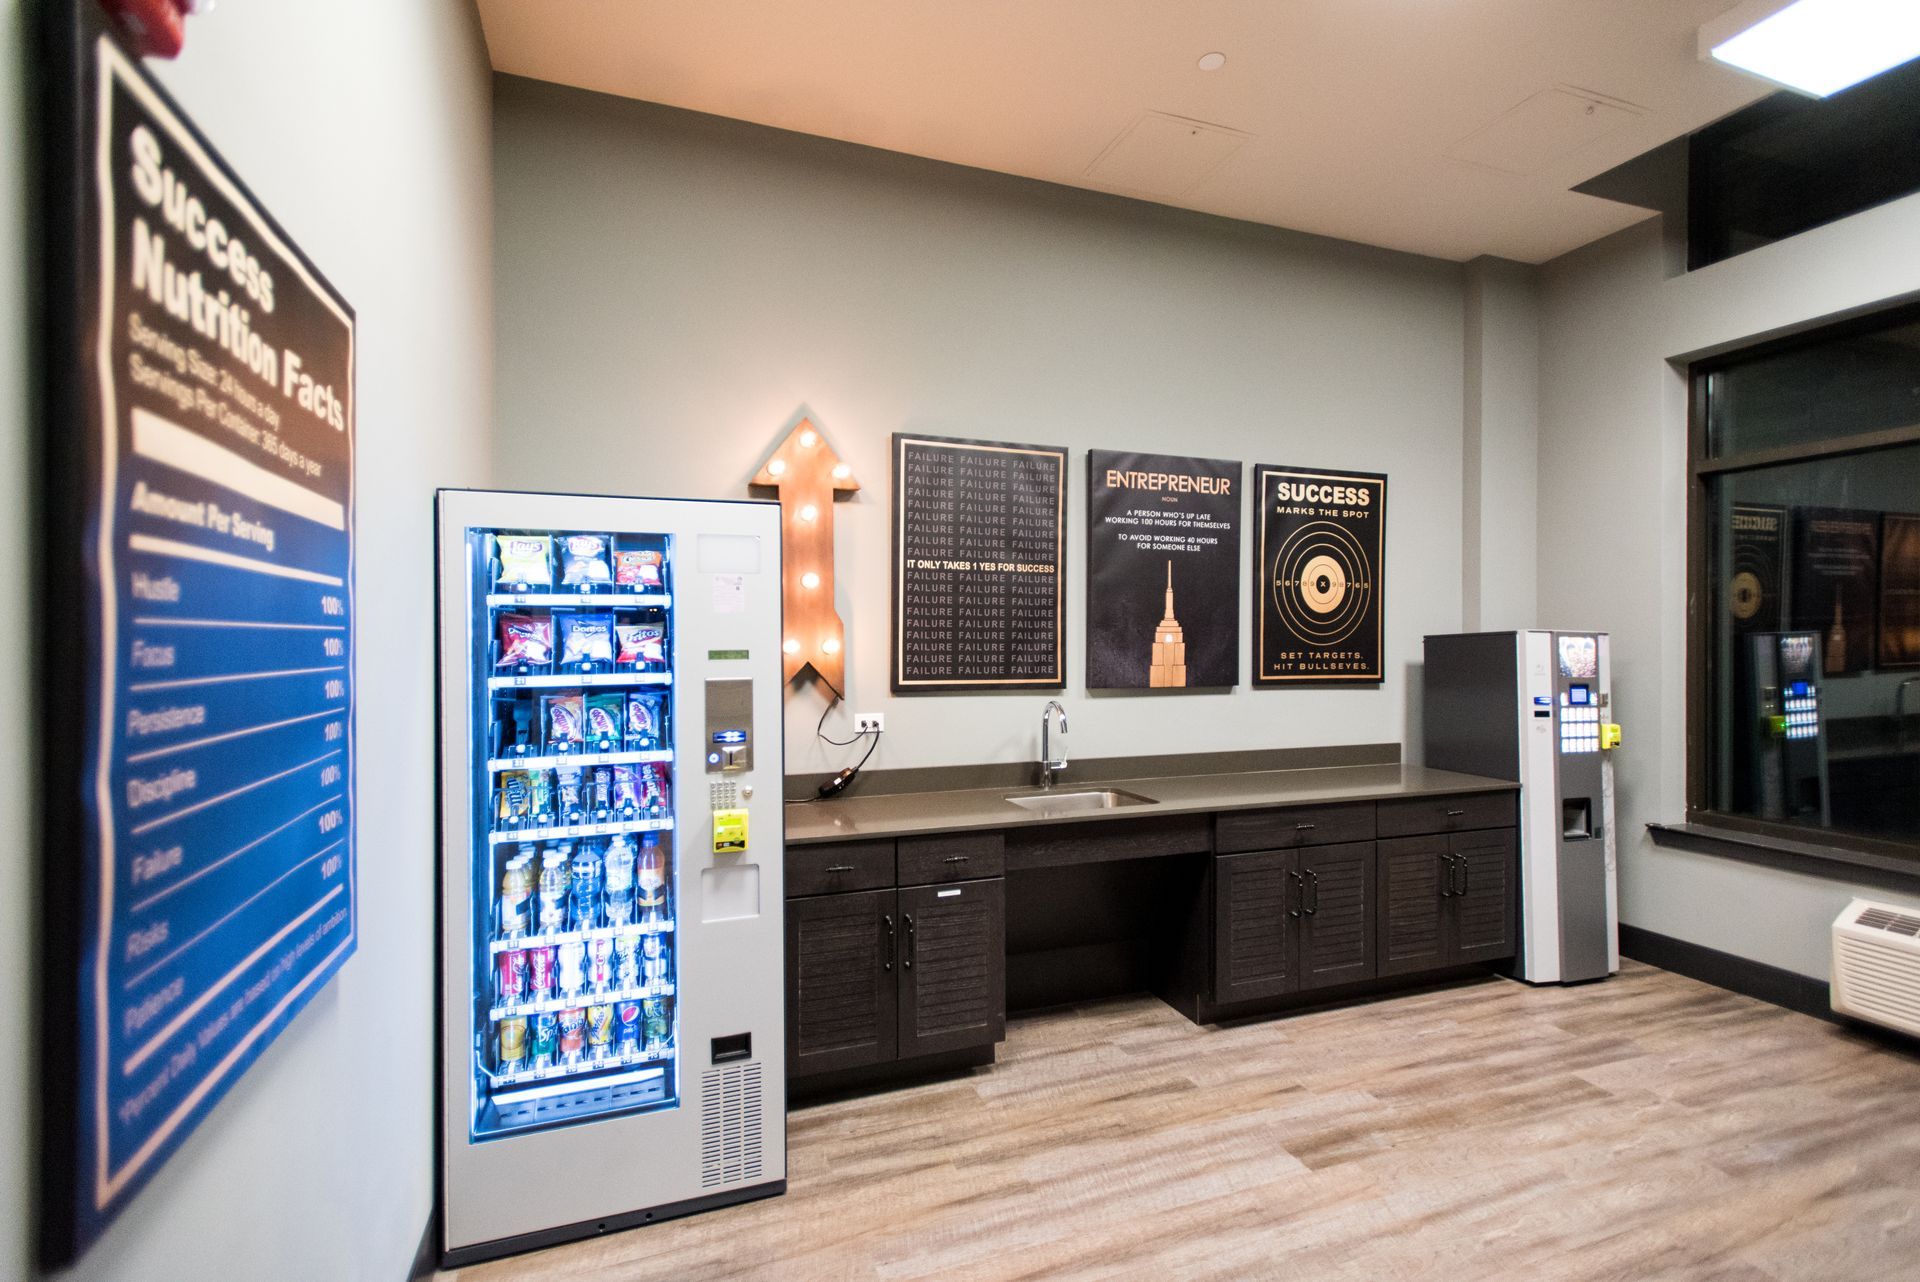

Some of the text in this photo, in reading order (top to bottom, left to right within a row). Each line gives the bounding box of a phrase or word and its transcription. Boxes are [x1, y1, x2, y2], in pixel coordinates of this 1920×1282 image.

[131, 125, 275, 314] Success
[131, 217, 344, 432] Nutrition Facts
[128, 312, 186, 373] Serving
[263, 405, 279, 431] day
[130, 353, 194, 410] Servings
[196, 388, 217, 419] Per
[262, 430, 278, 455] 365
[279, 441, 298, 467] days
[305, 458, 321, 476] year
[908, 452, 1055, 471] FAILURE FAILURE FAILURE
[908, 464, 1055, 482] FAILURE FAILURE FAILURE
[908, 476, 1054, 493] FAILURE FAILURE FAILURE
[1106, 470, 1230, 495] ENTREPRENEUR
[908, 488, 1054, 505] FAILURE FAILURE FAILURE
[1278, 482, 1370, 506] SUCCESS
[130, 481, 274, 552] Amount Per Serving
[908, 500, 1054, 516] FAILURE FAILURE FAILURE
[1277, 506, 1315, 515] MARKS
[1319, 509, 1338, 517] THE
[908, 512, 1054, 527] FAILURE FAILURE FAILURE
[908, 524, 1054, 538] FAILURE FAILURE FAILURE
[908, 536, 1054, 550] FAILURE FAILURE FAILURE
[1153, 543, 1185, 551] SOMEONE
[907, 548, 1054, 561] FAILURE FAILURE FAILURE
[907, 560, 915, 568] IT
[918, 561, 941, 569] ONLY
[943, 561, 970, 570] TAKES
[979, 562, 996, 570] YES
[998, 563, 1014, 571] FOR
[1017, 564, 1054, 573] SUCCESS
[907, 572, 1054, 584] FAILURE FAILURE FAILURE
[907, 584, 1054, 595] FAILURE FAILURE FAILURE
[322, 596, 344, 616] 100%
[907, 595, 1053, 606] FAILURE FAILURE FAILURE
[907, 607, 1053, 617] FAILURE FAILURE FAILURE
[907, 619, 1053, 628] FAILURE FAILURE FAILURE
[907, 631, 1053, 640] FAILURE FAILURE FAILURE
[324, 638, 344, 656] 100%
[907, 643, 1053, 651] FAILURE FAILURE FAILURE
[907, 654, 1053, 663] FAILURE FAILURE FAILURE
[907, 665, 1053, 674] FAILURE FAILURE FAILURE
[325, 680, 344, 699] 100%
[325, 721, 342, 741] 100%
[321, 765, 341, 786] 100%
[319, 809, 343, 834] 100%
[321, 854, 342, 880] 100%
